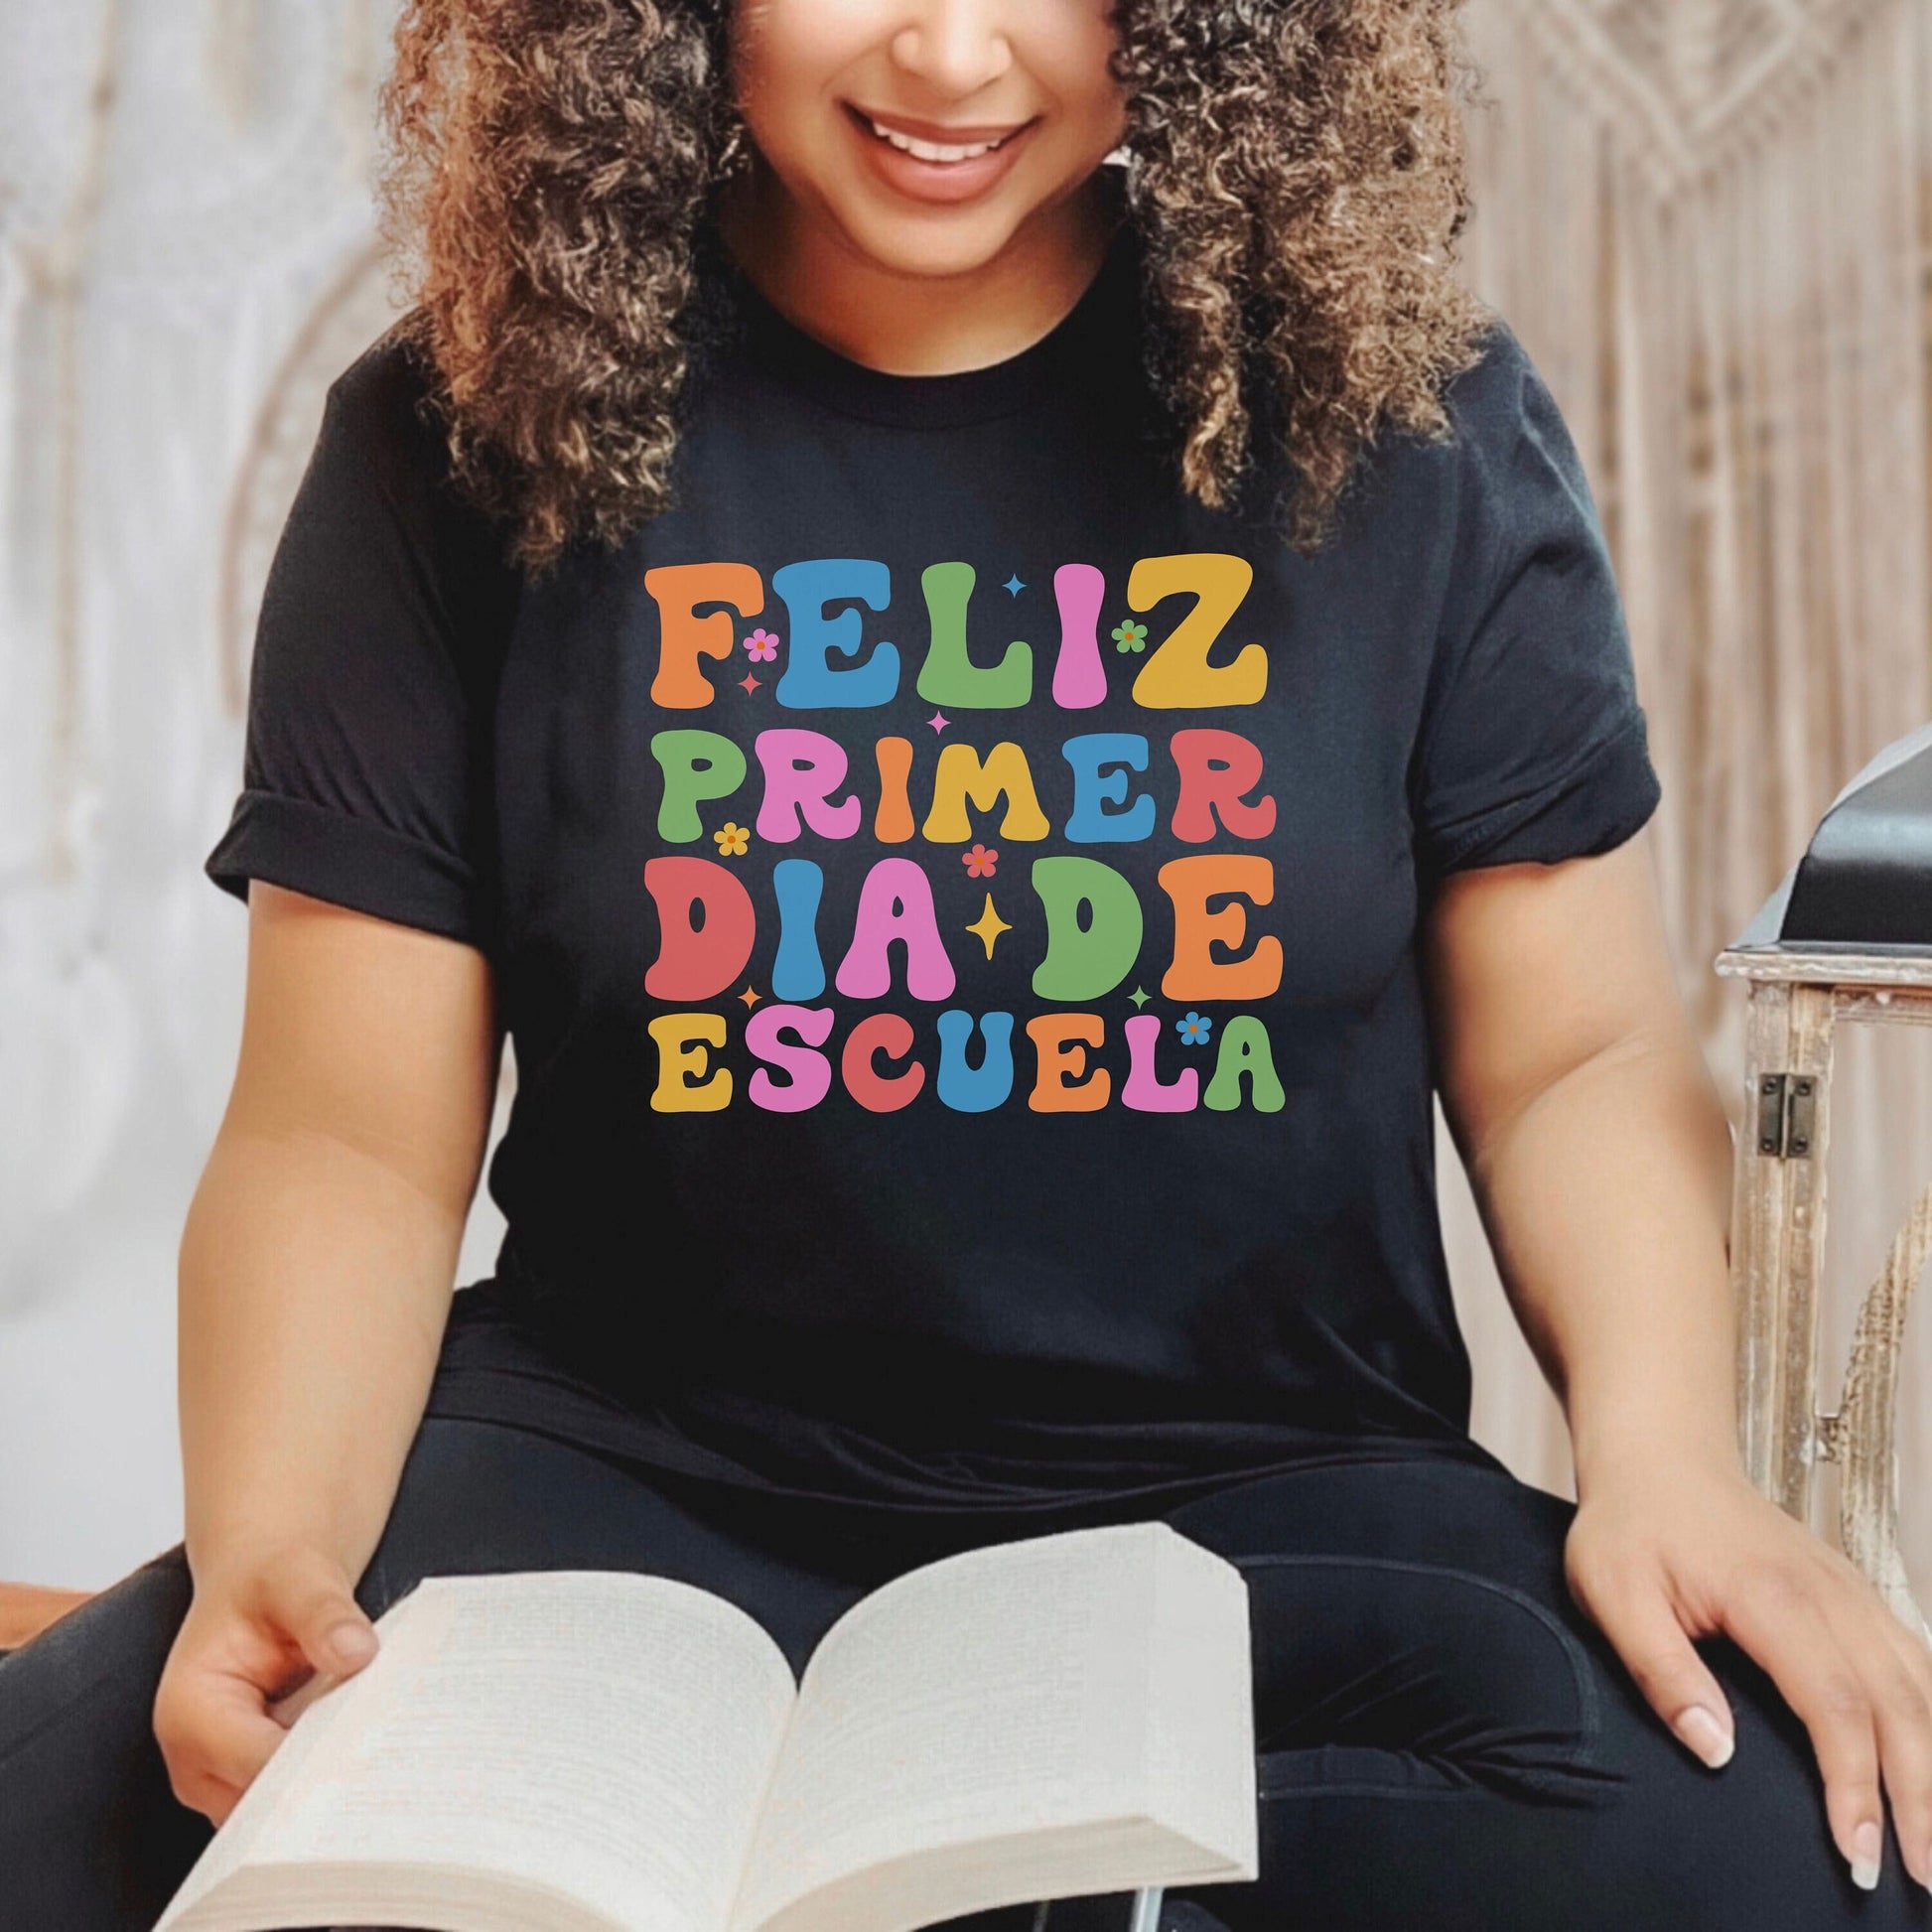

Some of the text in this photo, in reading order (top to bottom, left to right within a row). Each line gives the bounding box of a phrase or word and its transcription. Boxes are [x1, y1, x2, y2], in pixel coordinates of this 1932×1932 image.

[644, 552, 1269, 710] FELIZ
[650, 728, 1277, 844] PRIMER
[643, 854, 1284, 1002] DIA DE
[647, 1004, 1286, 1113] ESCUELA
